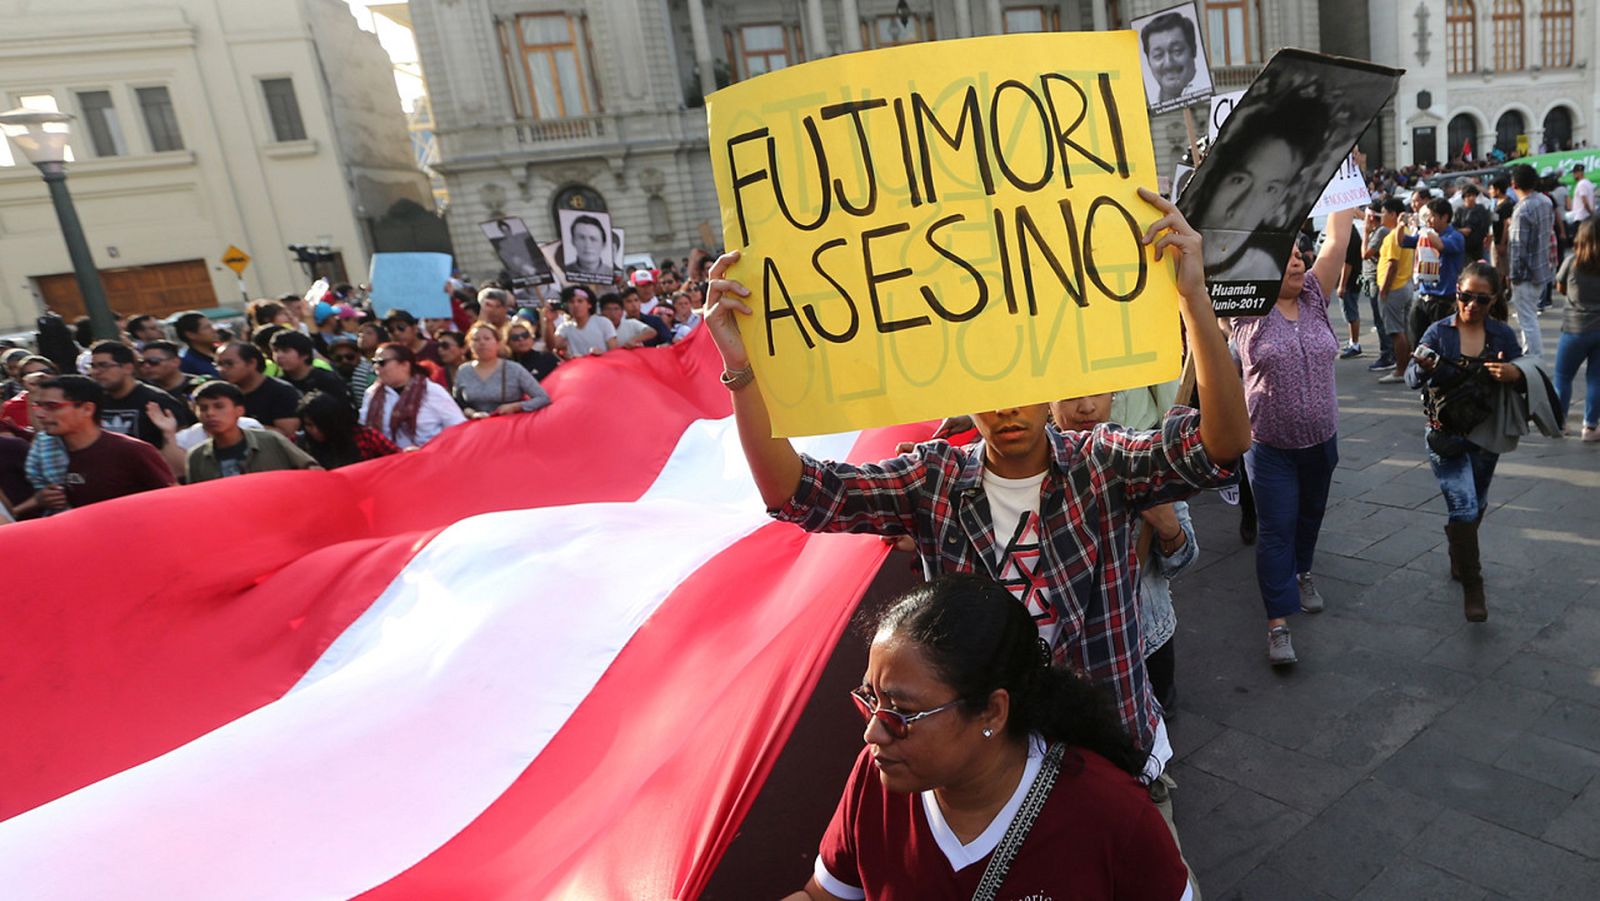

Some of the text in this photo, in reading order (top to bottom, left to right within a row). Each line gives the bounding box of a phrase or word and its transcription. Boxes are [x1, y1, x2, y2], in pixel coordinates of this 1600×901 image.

[727, 72, 1130, 248] FUJIMORI
[763, 195, 1147, 356] ASESINO
[1211, 282, 1257, 296] Huamán
